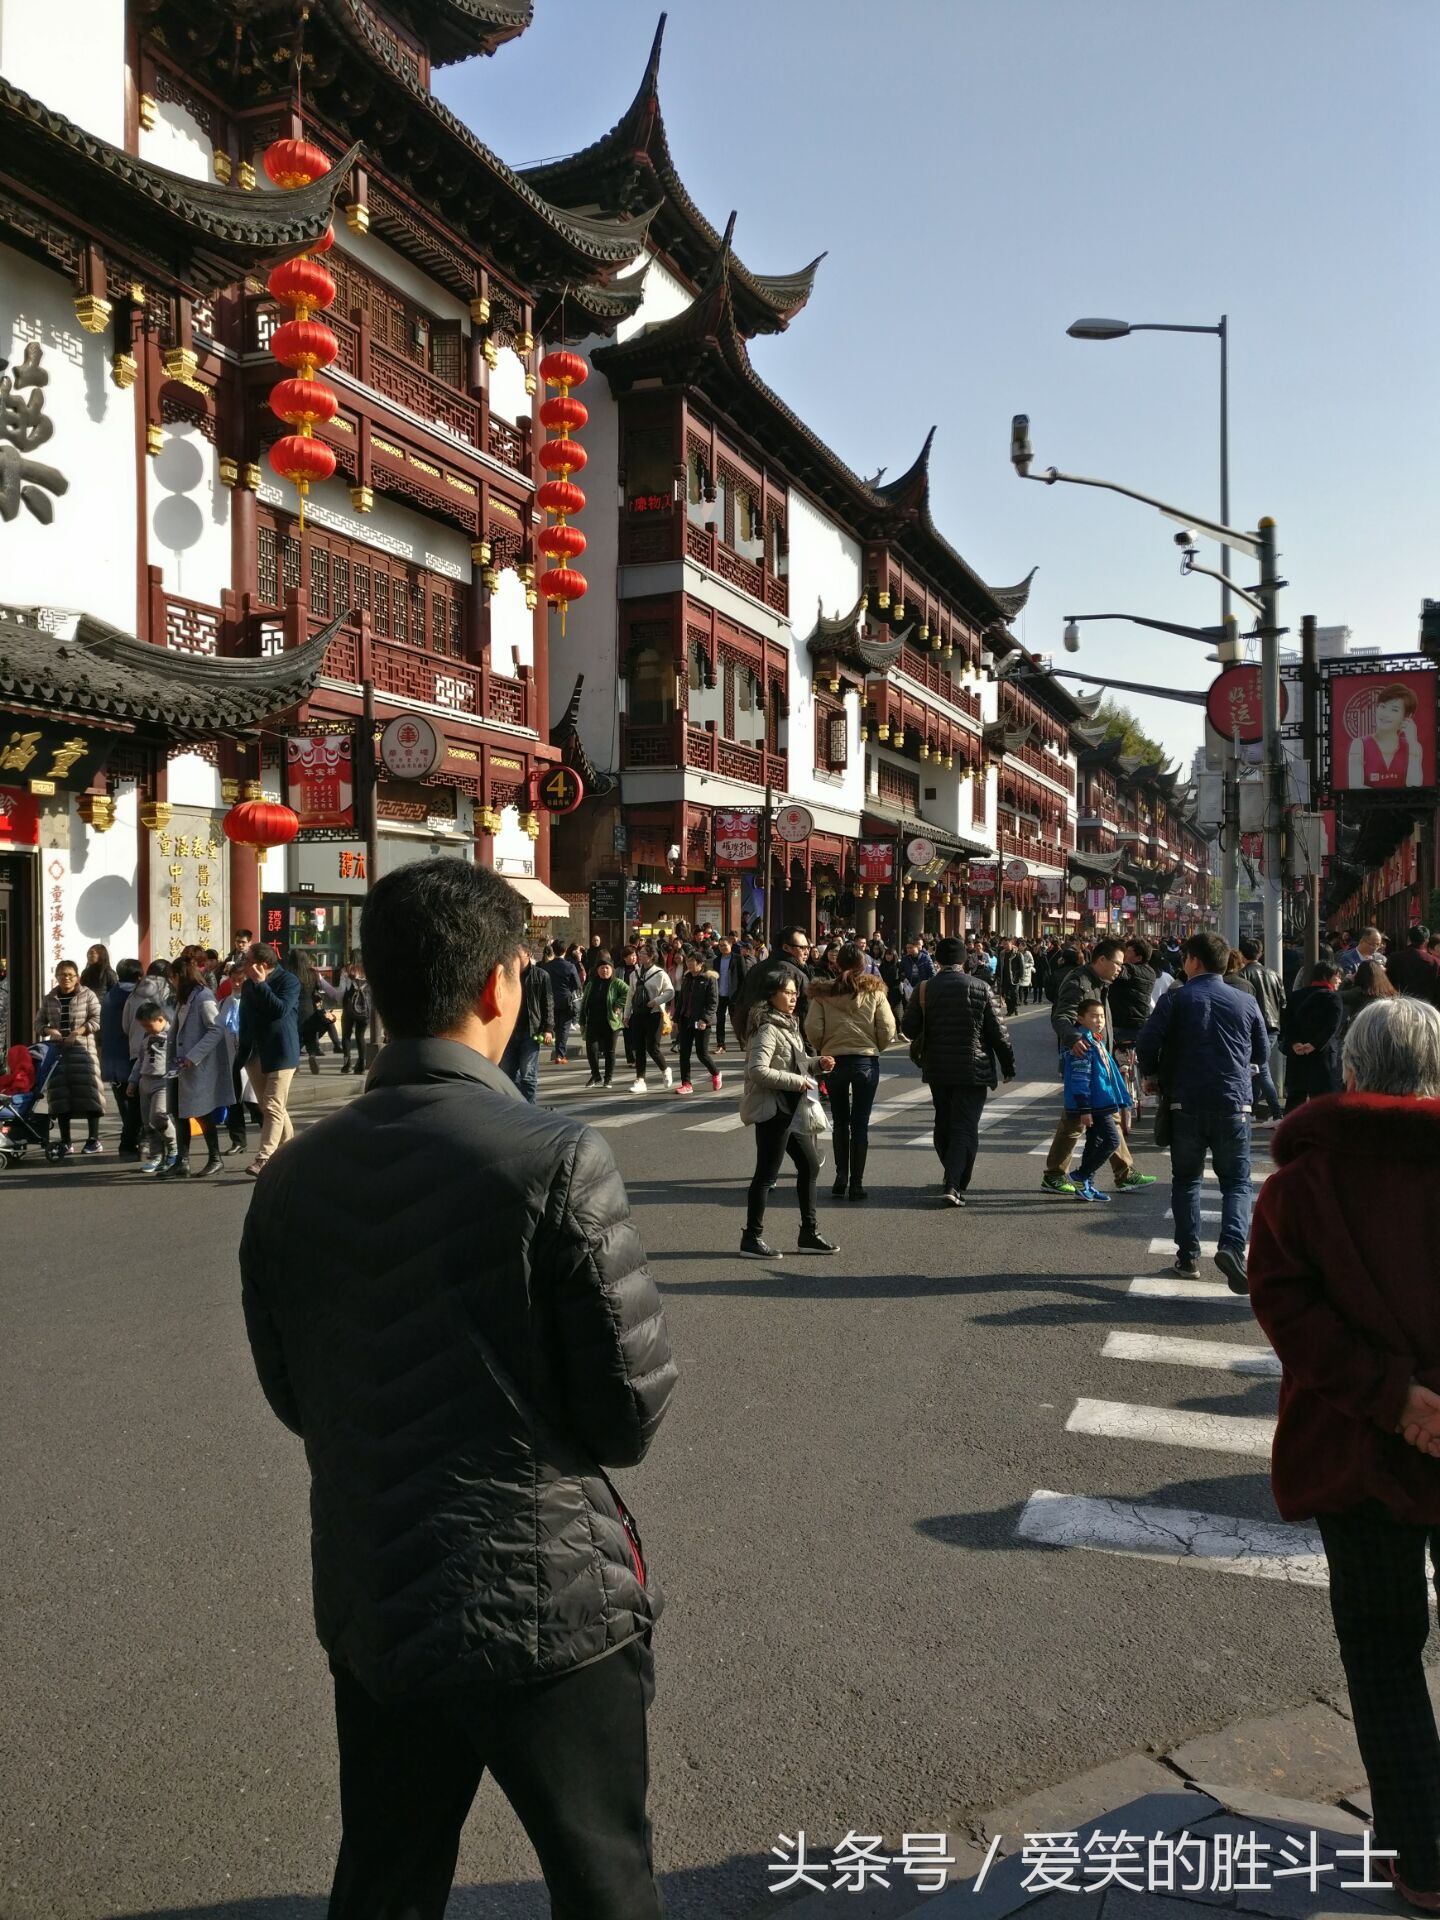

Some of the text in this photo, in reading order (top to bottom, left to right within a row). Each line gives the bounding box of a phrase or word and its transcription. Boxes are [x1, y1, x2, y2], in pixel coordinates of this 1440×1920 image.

[546, 771, 567, 797] 4
[158, 833, 218, 860] 童涵春堂
